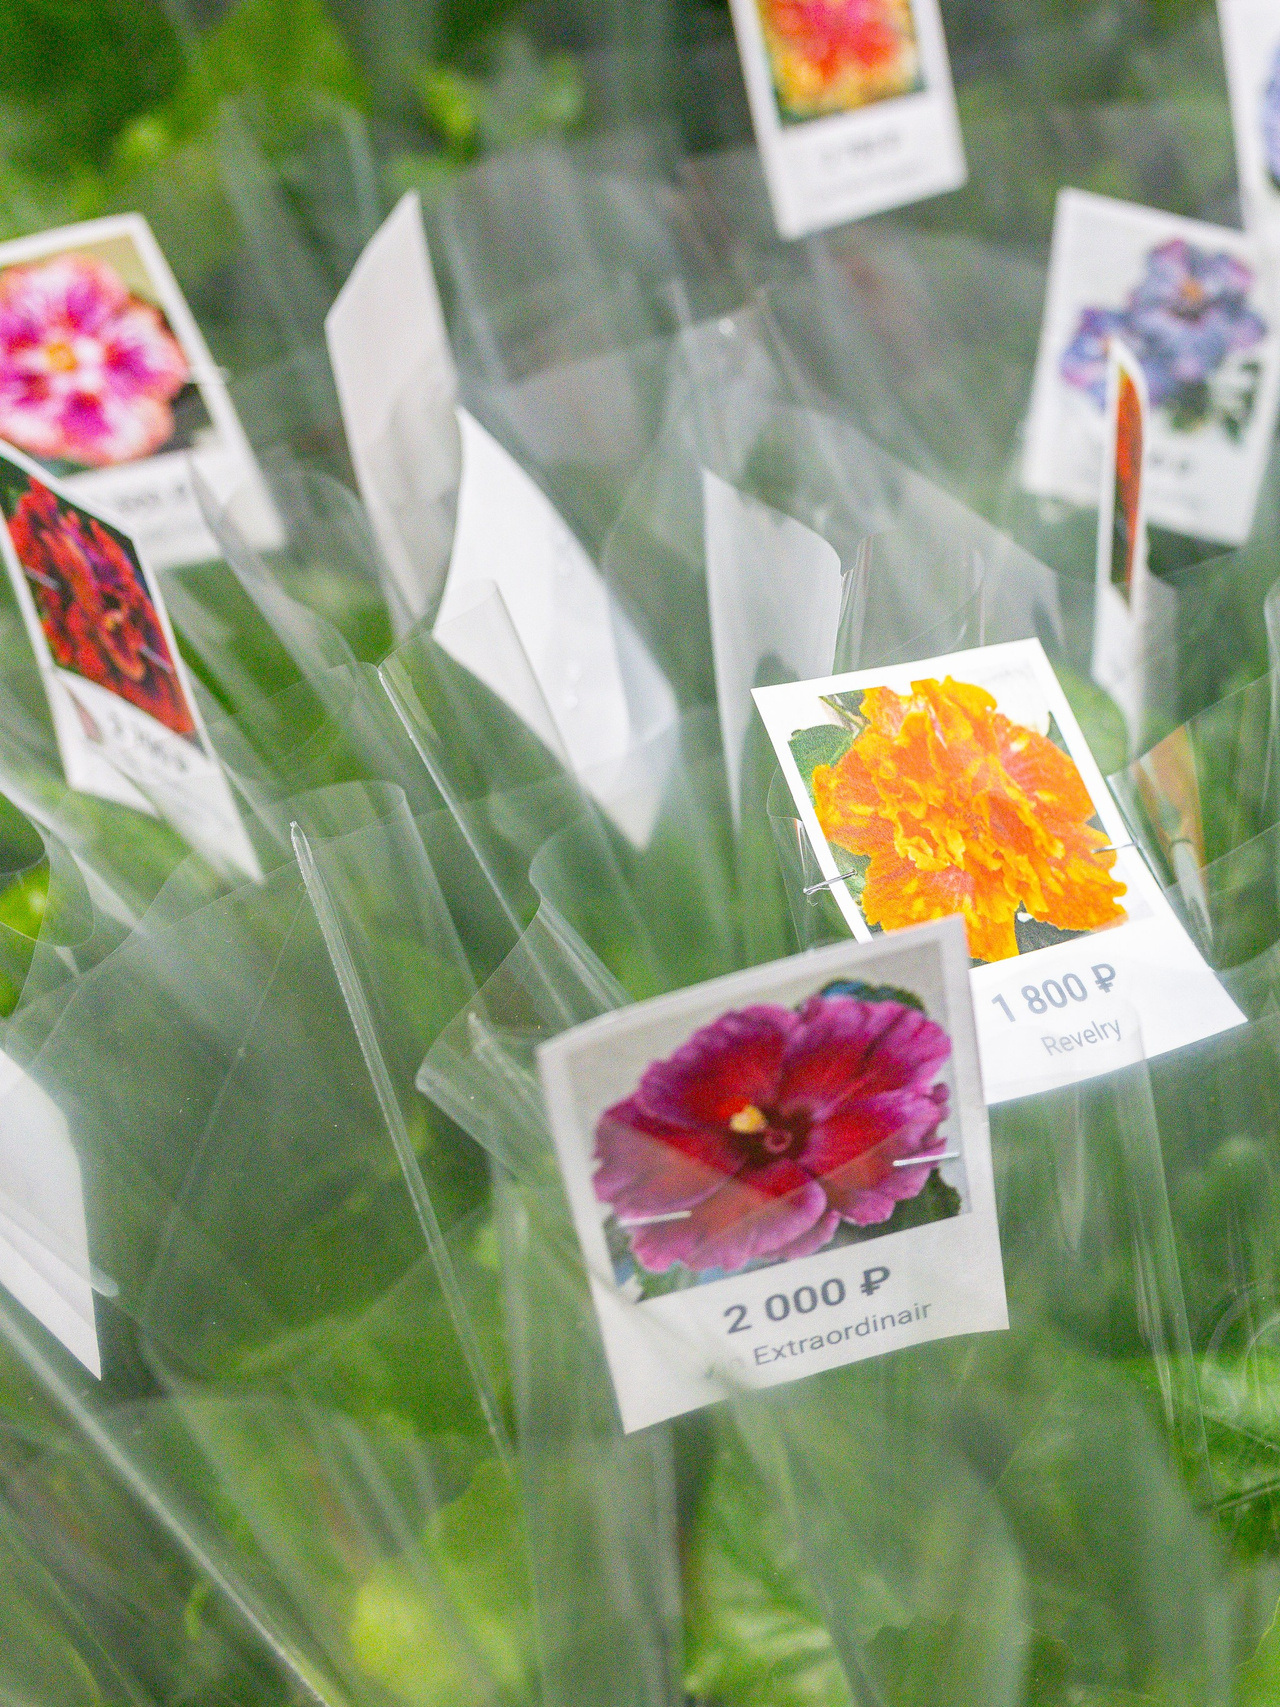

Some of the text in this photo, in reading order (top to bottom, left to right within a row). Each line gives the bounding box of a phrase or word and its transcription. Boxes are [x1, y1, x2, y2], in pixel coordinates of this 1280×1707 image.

[990, 963, 1117, 1023] 1 800 ₽
[1040, 1018, 1123, 1057] Revelry
[722, 1265, 892, 1335] 2 000 ₽
[752, 1300, 934, 1367] Extraordinair
